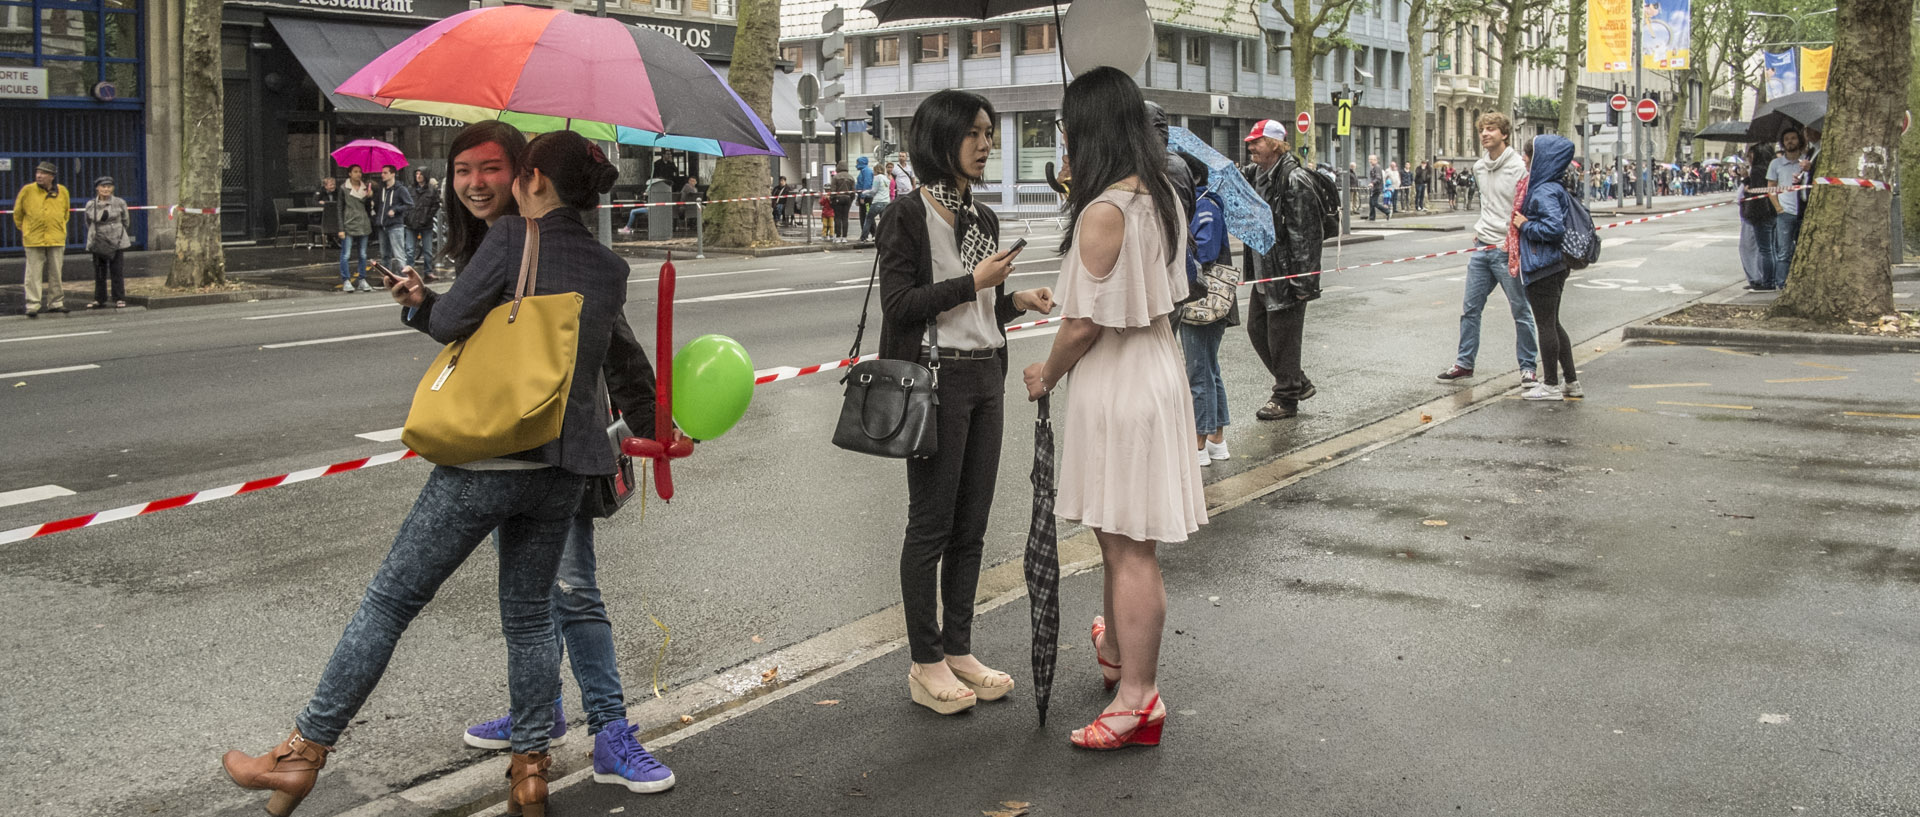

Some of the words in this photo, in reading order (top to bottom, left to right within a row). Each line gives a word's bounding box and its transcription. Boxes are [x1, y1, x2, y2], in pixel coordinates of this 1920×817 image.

[299, 0, 413, 13] staurant
[636, 23, 711, 48] BLOS
[0, 71, 29, 81] ORTIE
[419, 115, 464, 127] BYBLOS
